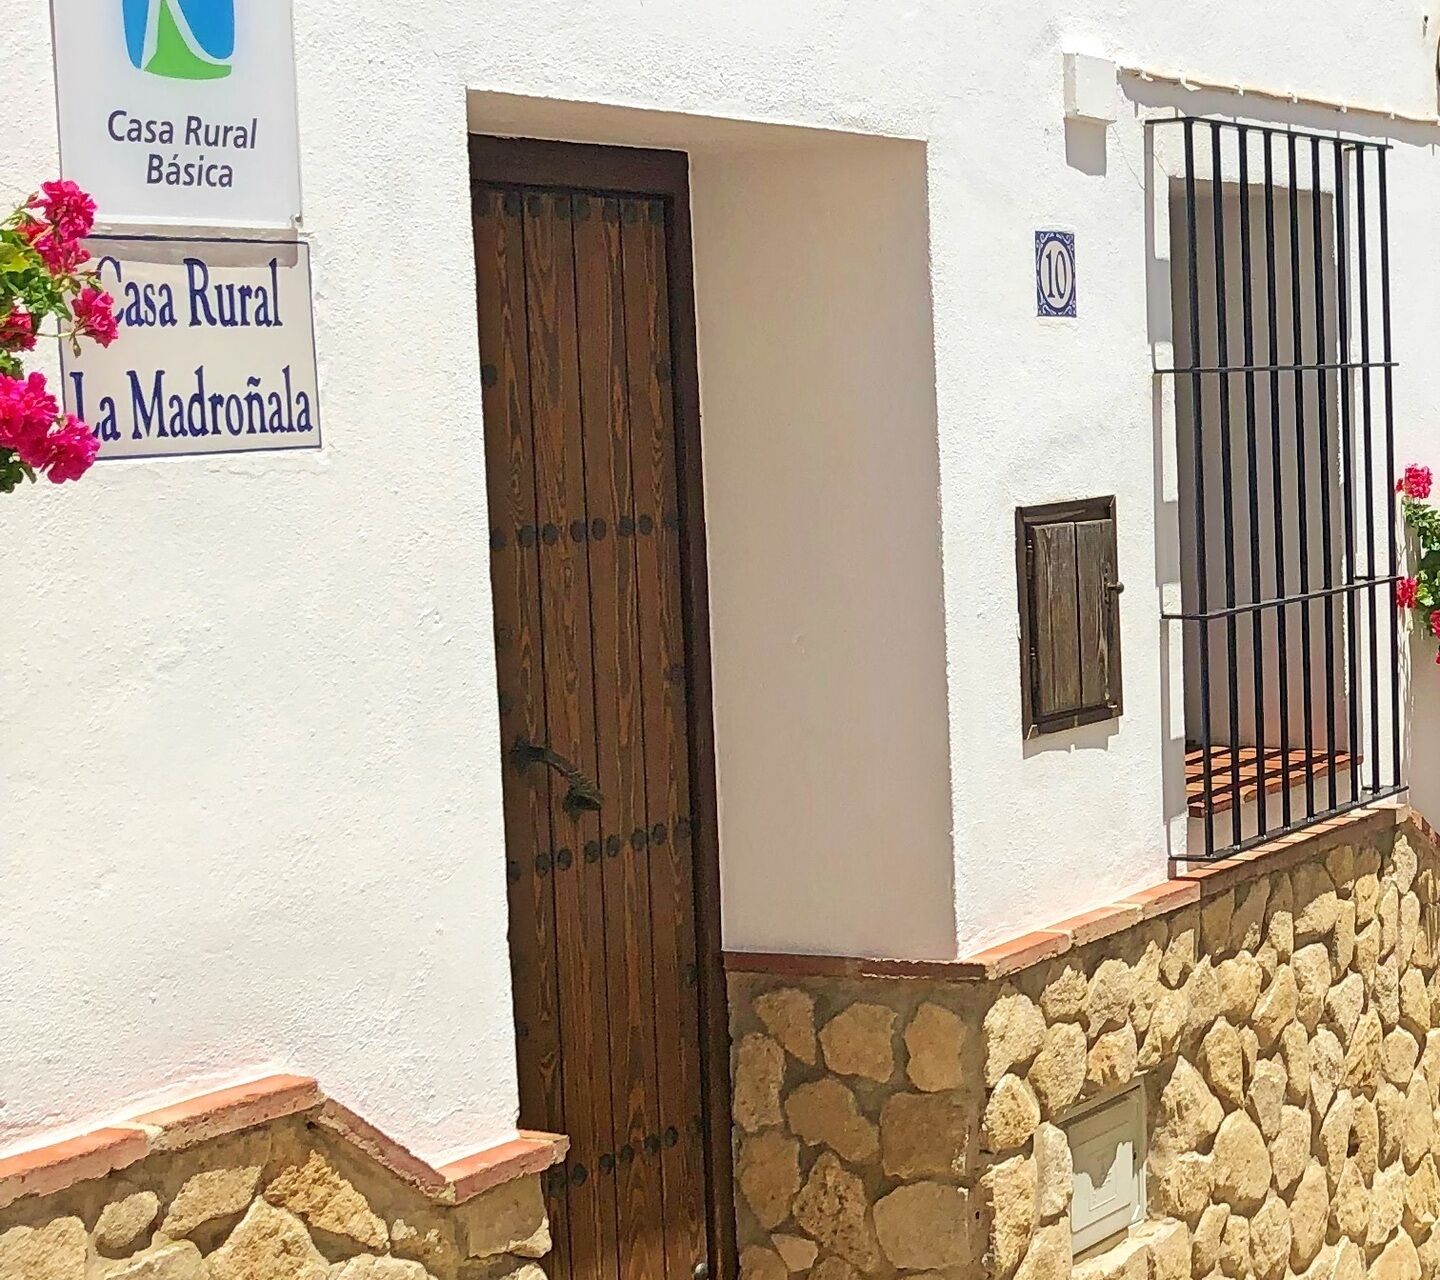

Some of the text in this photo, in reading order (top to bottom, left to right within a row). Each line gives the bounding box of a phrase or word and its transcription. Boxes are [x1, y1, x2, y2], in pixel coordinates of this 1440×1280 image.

[107, 109, 258, 149] Casa Rural
[147, 153, 234, 188] Básica
[183, 257, 283, 327] Rural
[1045, 249, 1067, 299] 10
[69, 364, 314, 441] La Madroñala
